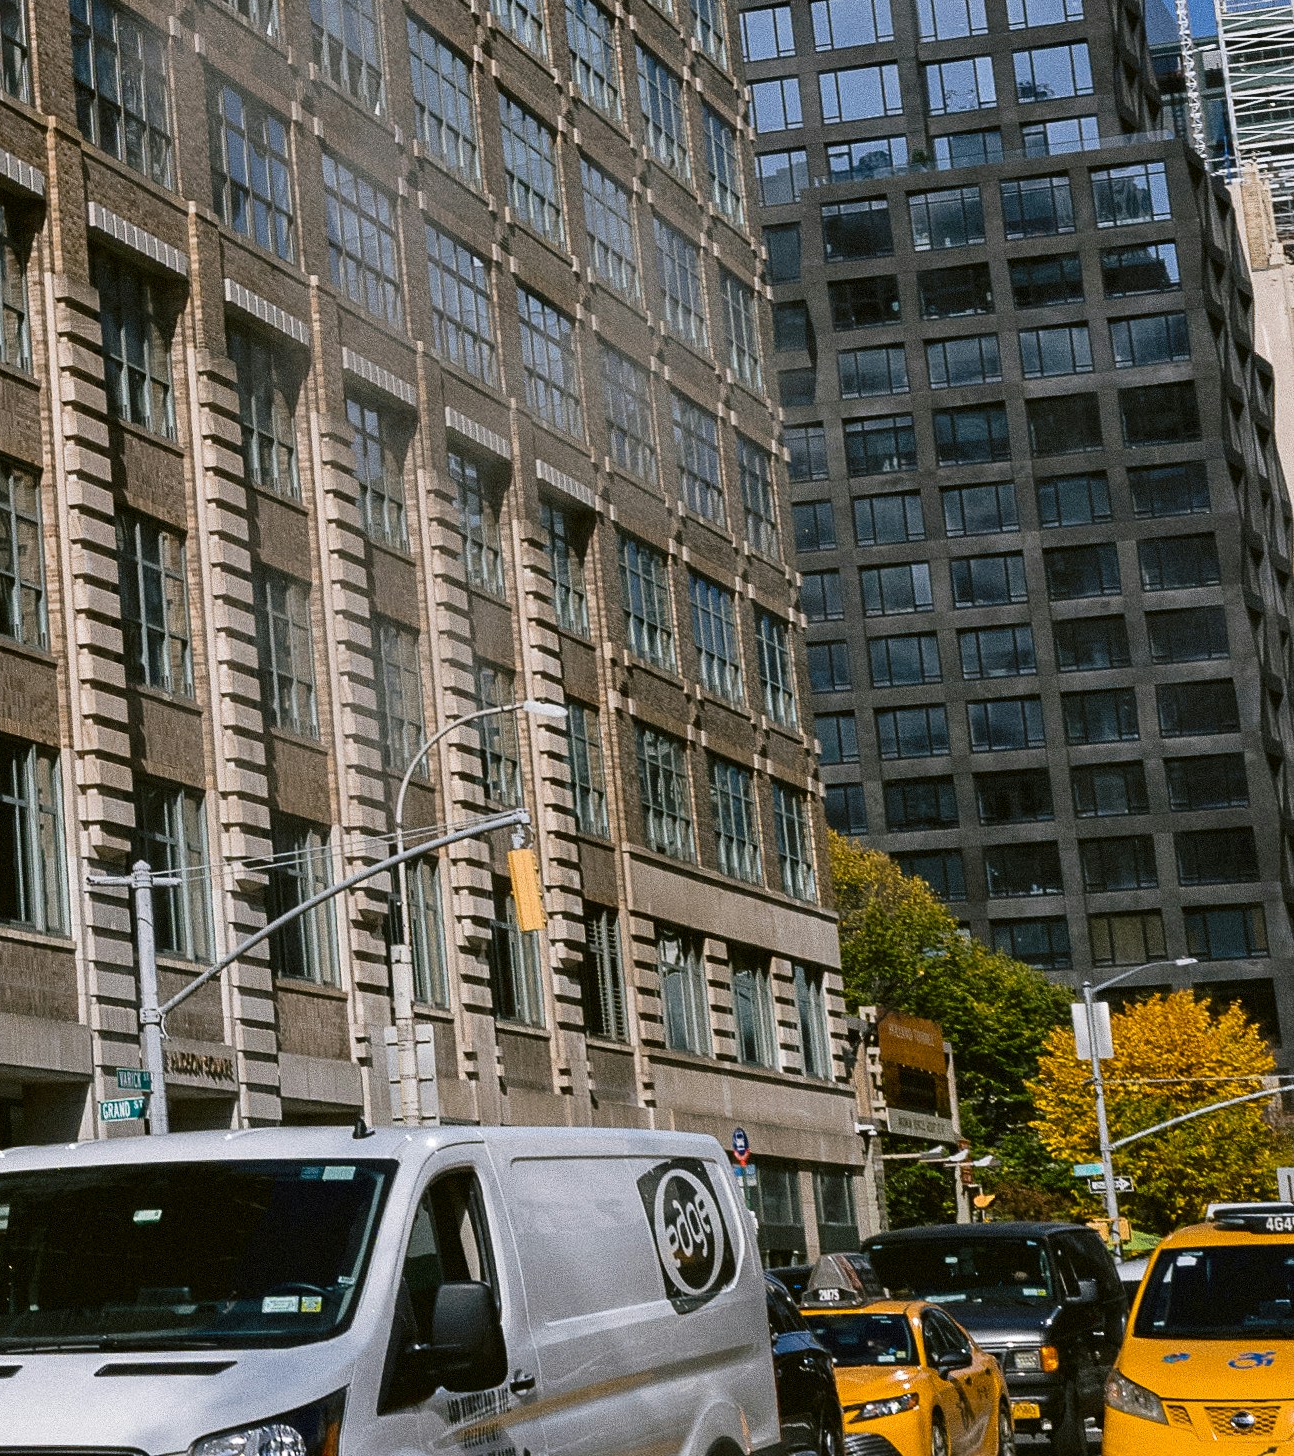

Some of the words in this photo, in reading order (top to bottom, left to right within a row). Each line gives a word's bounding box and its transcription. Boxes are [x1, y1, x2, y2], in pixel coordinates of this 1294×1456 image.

[119, 1071, 142, 1088] VARICK
[102, 1101, 131, 1120] GRAND
[133, 1099, 143, 1110] ST
[662, 1192, 713, 1269] edge
[1266, 1216, 1294, 1232] 4G4
